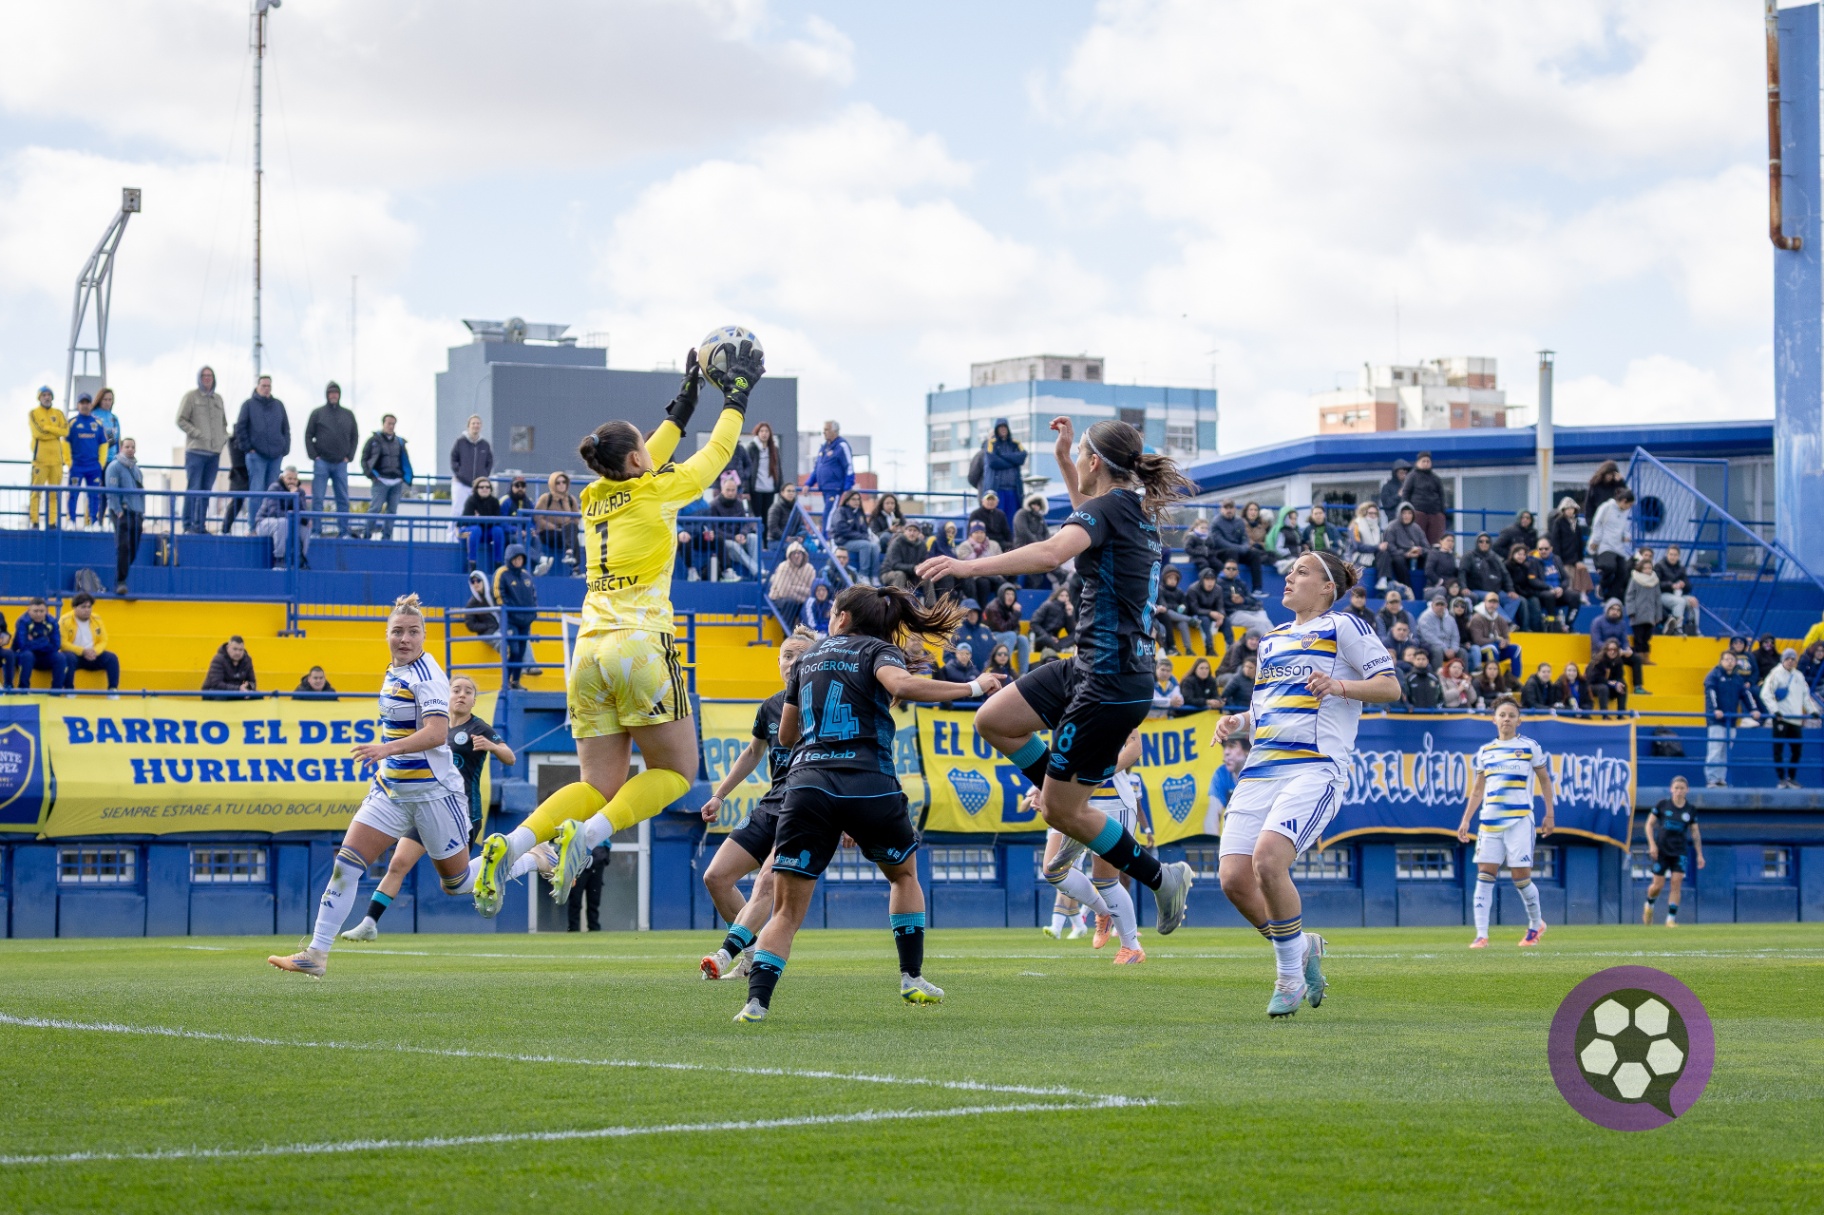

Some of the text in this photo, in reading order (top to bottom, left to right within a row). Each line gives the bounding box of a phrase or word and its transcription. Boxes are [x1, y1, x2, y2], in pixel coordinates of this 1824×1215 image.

[595, 520, 615, 579] 1
[1362, 656, 1393, 672] CETROGA
[801, 679, 860, 746] 14
[62, 716, 230, 745] BARRIO
[242, 719, 288, 745] EL
[933, 720, 965, 757] EL
[1057, 722, 1077, 753] 8
[805, 750, 856, 762] teclab
[101, 805, 158, 819] SIEMPRE
[161, 803, 211, 817] ESTARE
[212, 803, 222, 815] A
[225, 803, 244, 815] TU
[246, 803, 283, 815] LADO
[285, 803, 322, 816] BOCA
